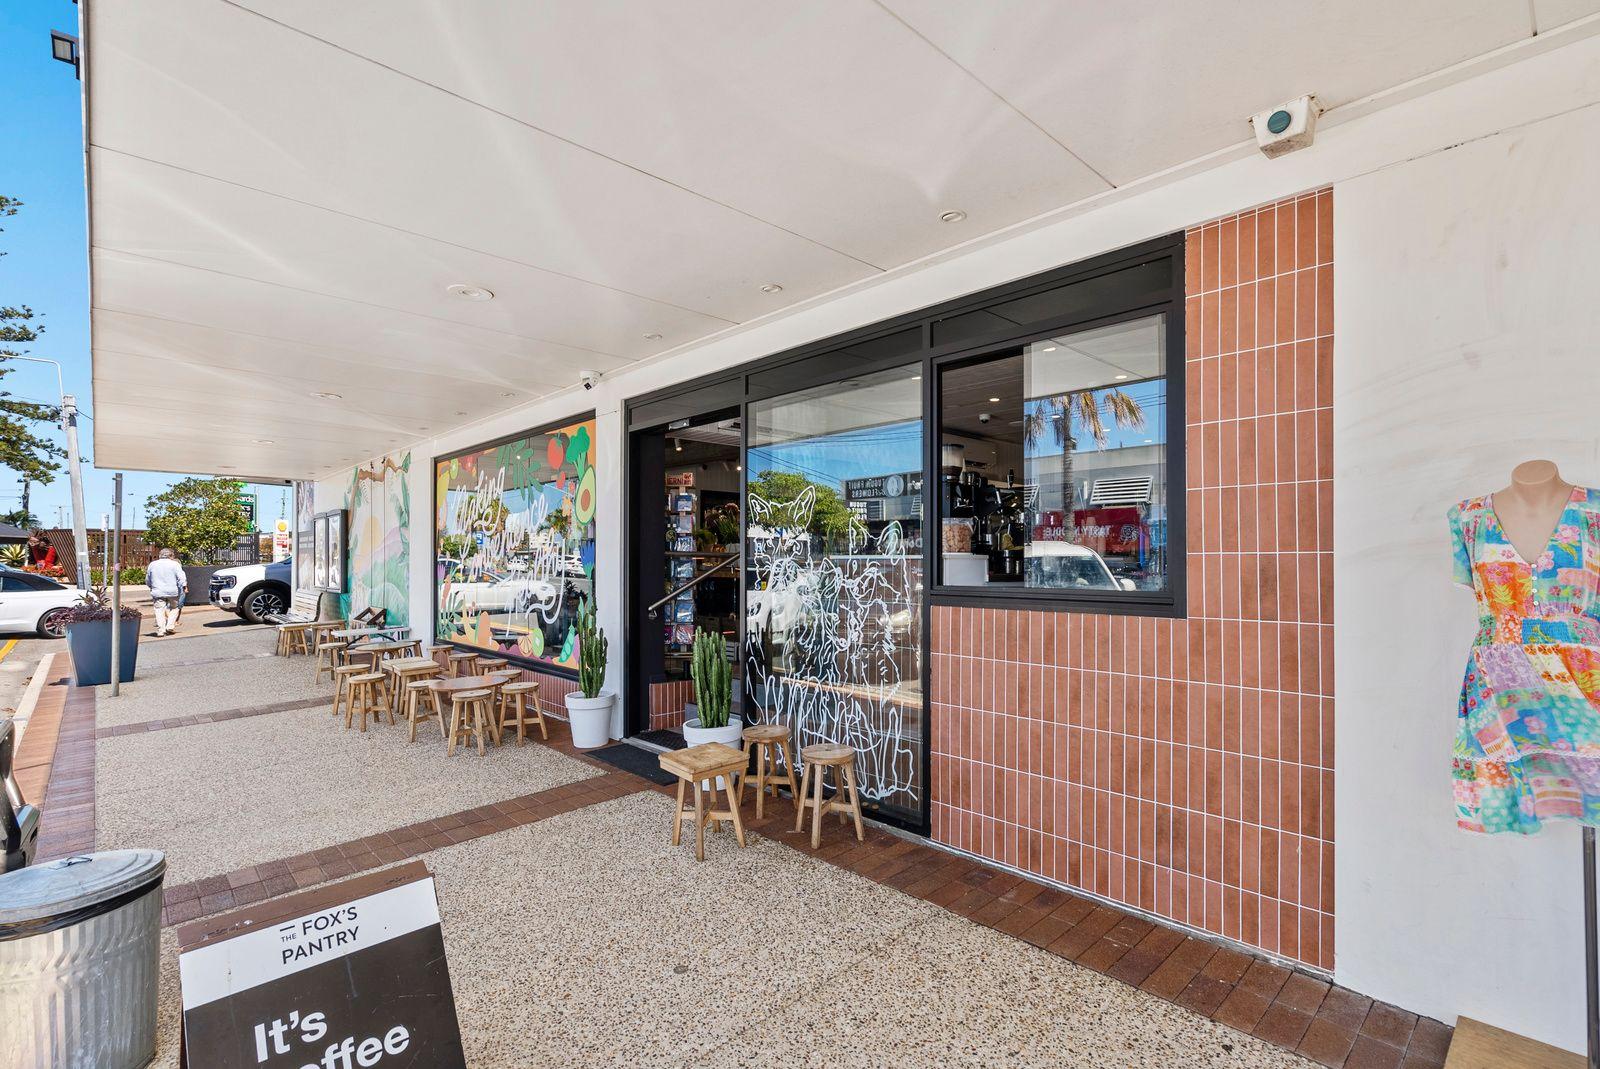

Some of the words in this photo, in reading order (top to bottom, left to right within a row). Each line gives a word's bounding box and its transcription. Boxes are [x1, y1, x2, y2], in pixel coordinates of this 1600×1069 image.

[281, 932, 297, 943] THE
[302, 906, 358, 936] FOX'S
[281, 926, 359, 965] PANTRY
[254, 1010, 328, 1063] It's
